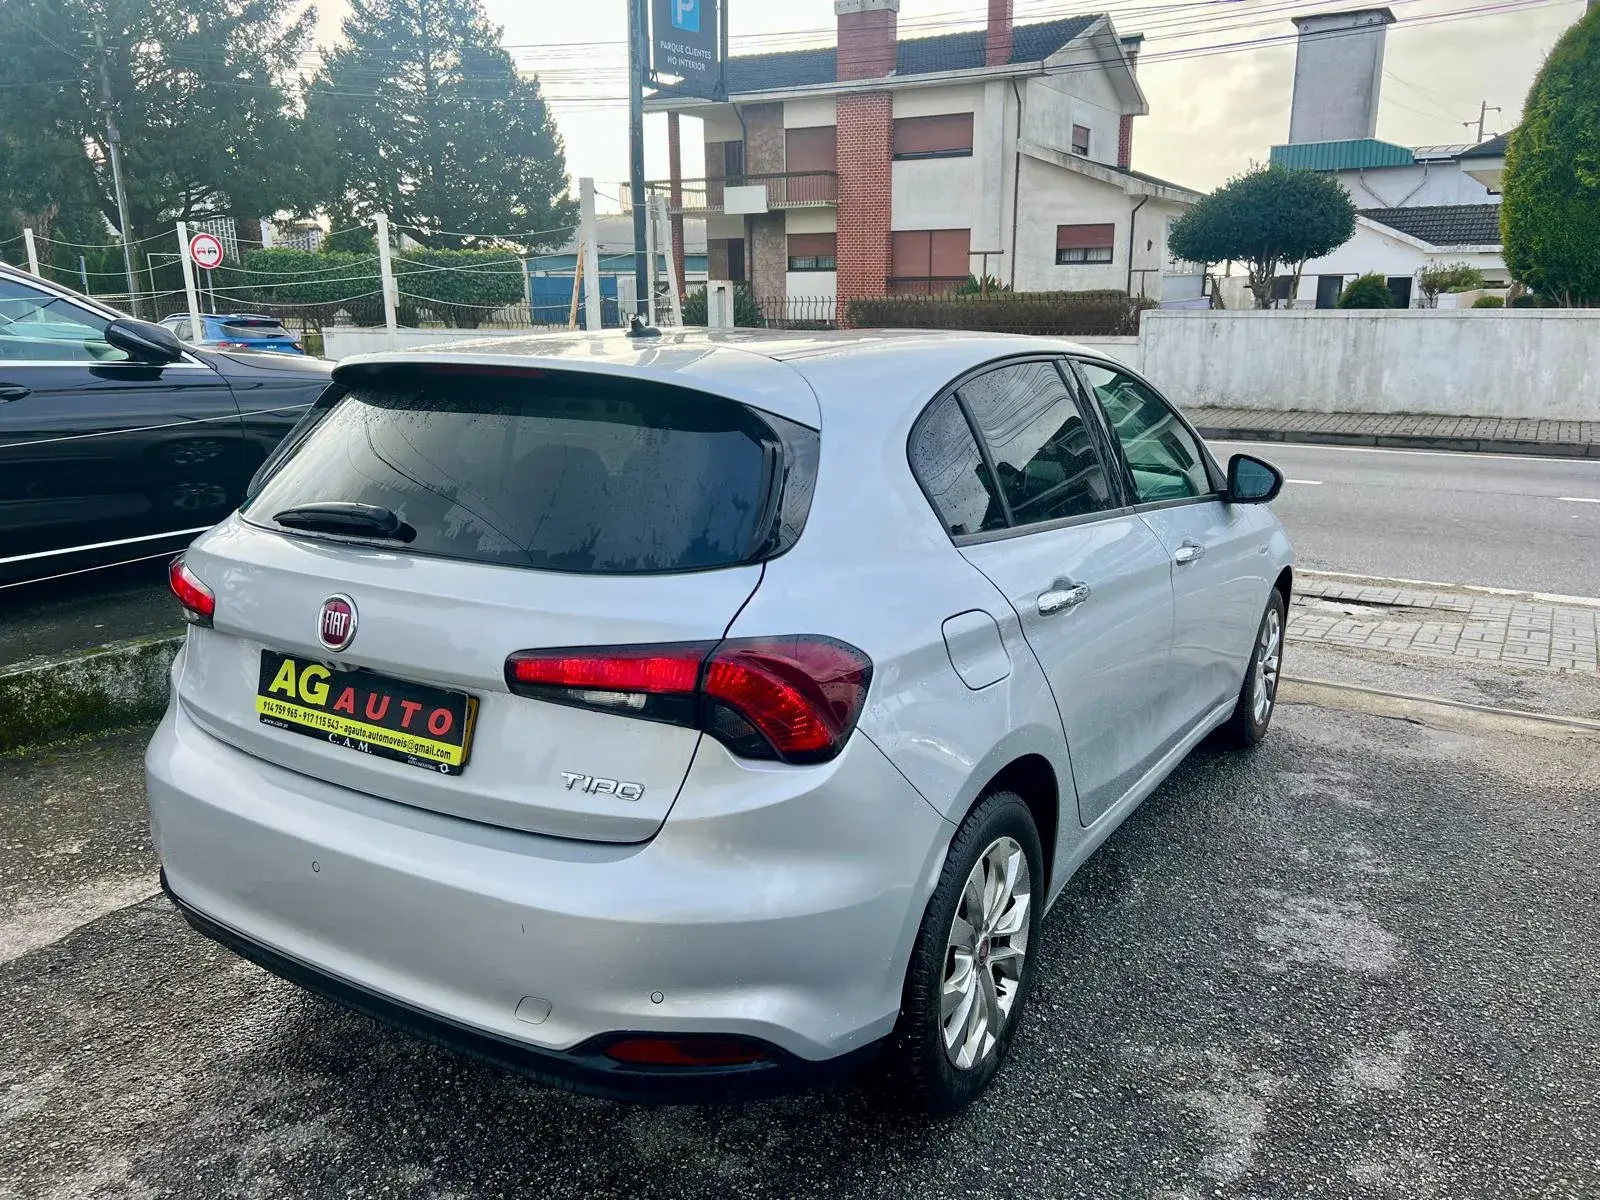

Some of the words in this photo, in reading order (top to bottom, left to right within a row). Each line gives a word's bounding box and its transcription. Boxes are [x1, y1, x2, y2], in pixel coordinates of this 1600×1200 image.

[677, 0, 694, 24] P
[660, 40, 684, 54] PARQUE
[685, 46, 712, 60] CLIENTES
[667, 55, 677, 65] NO
[678, 58, 706, 71] INTERIOR
[324, 610, 348, 637] FIAT
[269, 659, 331, 706] AG
[332, 686, 453, 737] AUTO
[263, 701, 274, 711] 914
[275, 703, 286, 715] 759
[287, 707, 298, 718] 965
[303, 711, 314, 723] 917
[316, 715, 327, 726] 115
[327, 718, 339, 730] 543
[343, 725, 451, 760] agauto.automoveis@gmail.com
[328, 733, 340, 744] C.
[342, 737, 355, 748] A.
[357, 741, 372, 754] M.
[560, 771, 645, 801] TIPO
